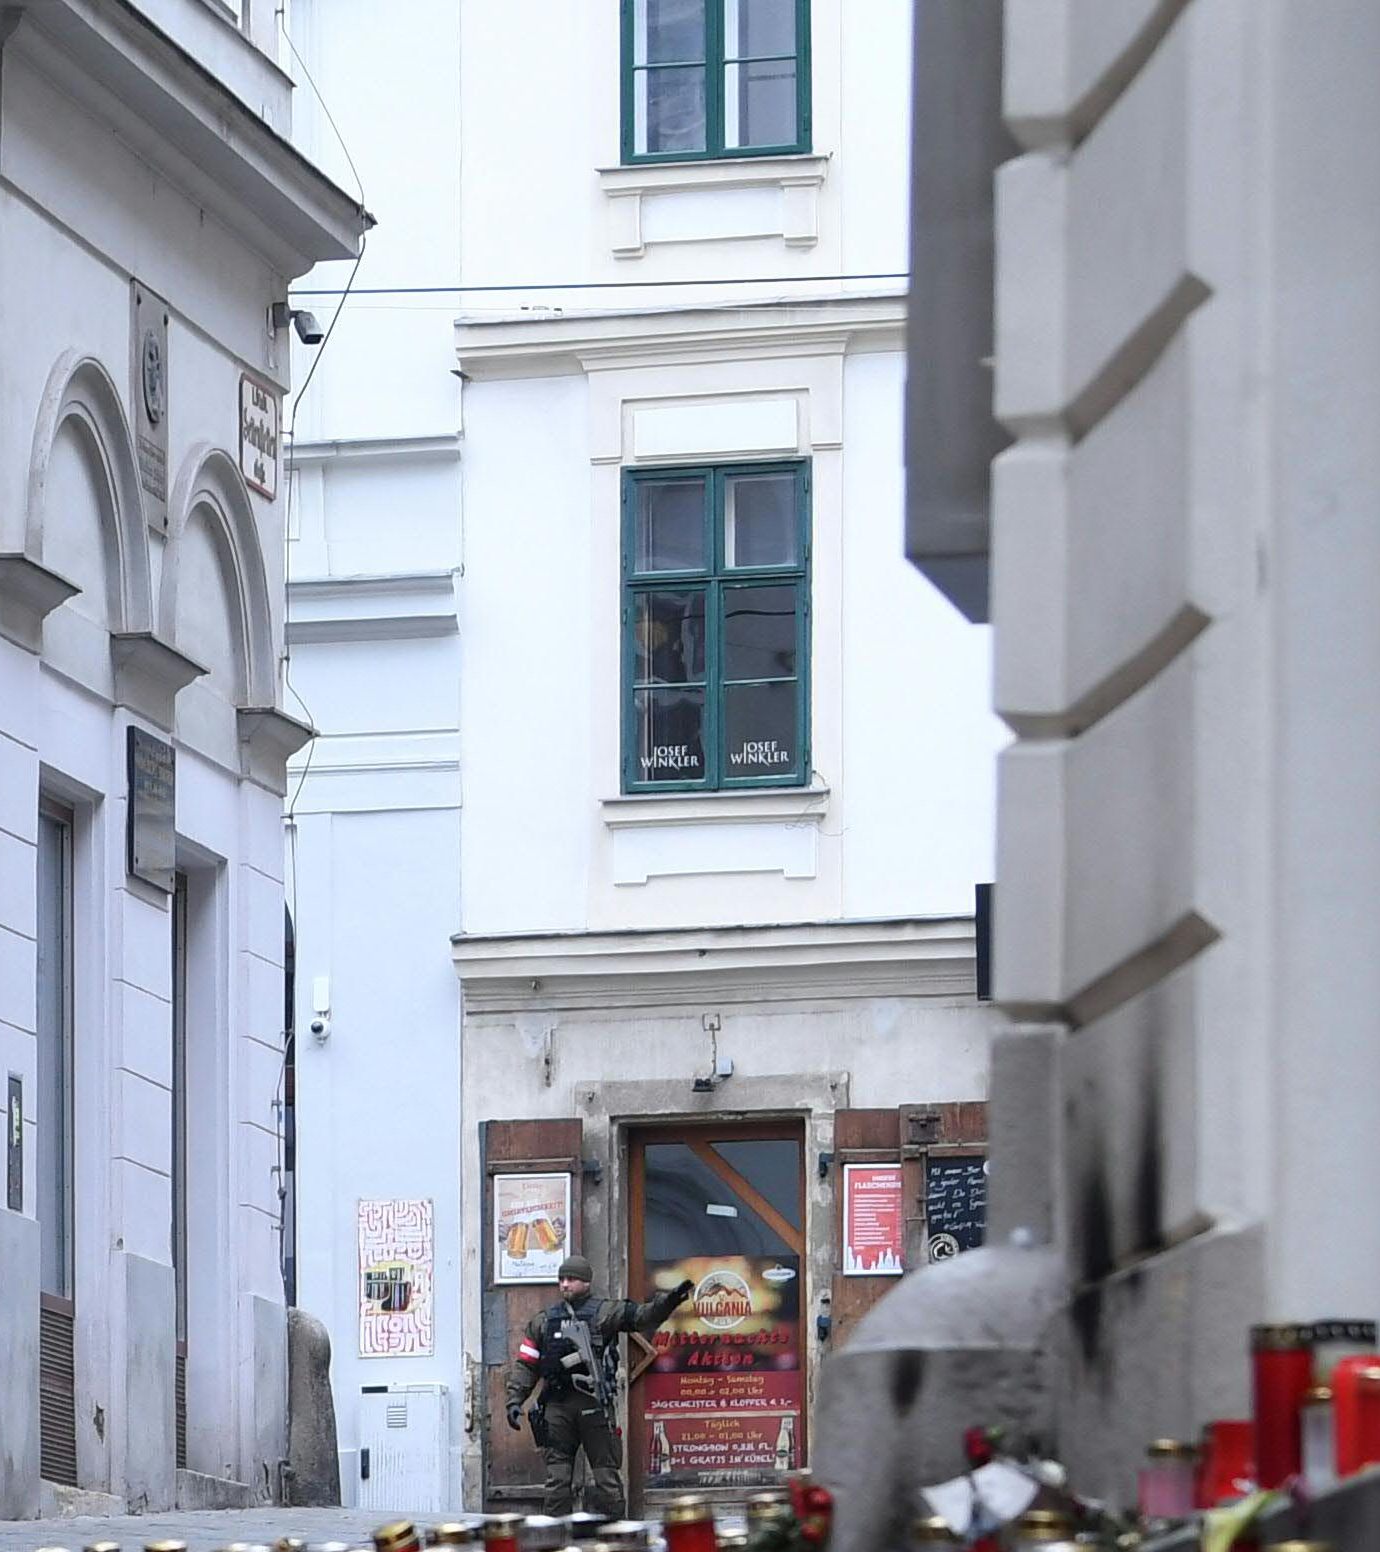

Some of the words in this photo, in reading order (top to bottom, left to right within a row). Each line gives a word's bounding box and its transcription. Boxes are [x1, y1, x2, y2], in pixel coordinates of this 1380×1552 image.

[654, 745, 689, 758] JOSEF
[743, 741, 778, 754] JOSEF
[640, 755, 700, 771] WINKLER
[730, 751, 790, 766] WINKLER
[653, 1329, 789, 1346] Mitternachts
[688, 1352, 755, 1366] Aktion
[680, 1375, 715, 1386] Montag
[726, 1374, 765, 1385] Samstag
[747, 1386, 764, 1395] Uhr
[704, 1420, 740, 1430] Täglich
[747, 1430, 764, 1440] Uhr
[672, 1443, 728, 1453] STRONGBOW
[689, 1455, 726, 1465] GRATIS
